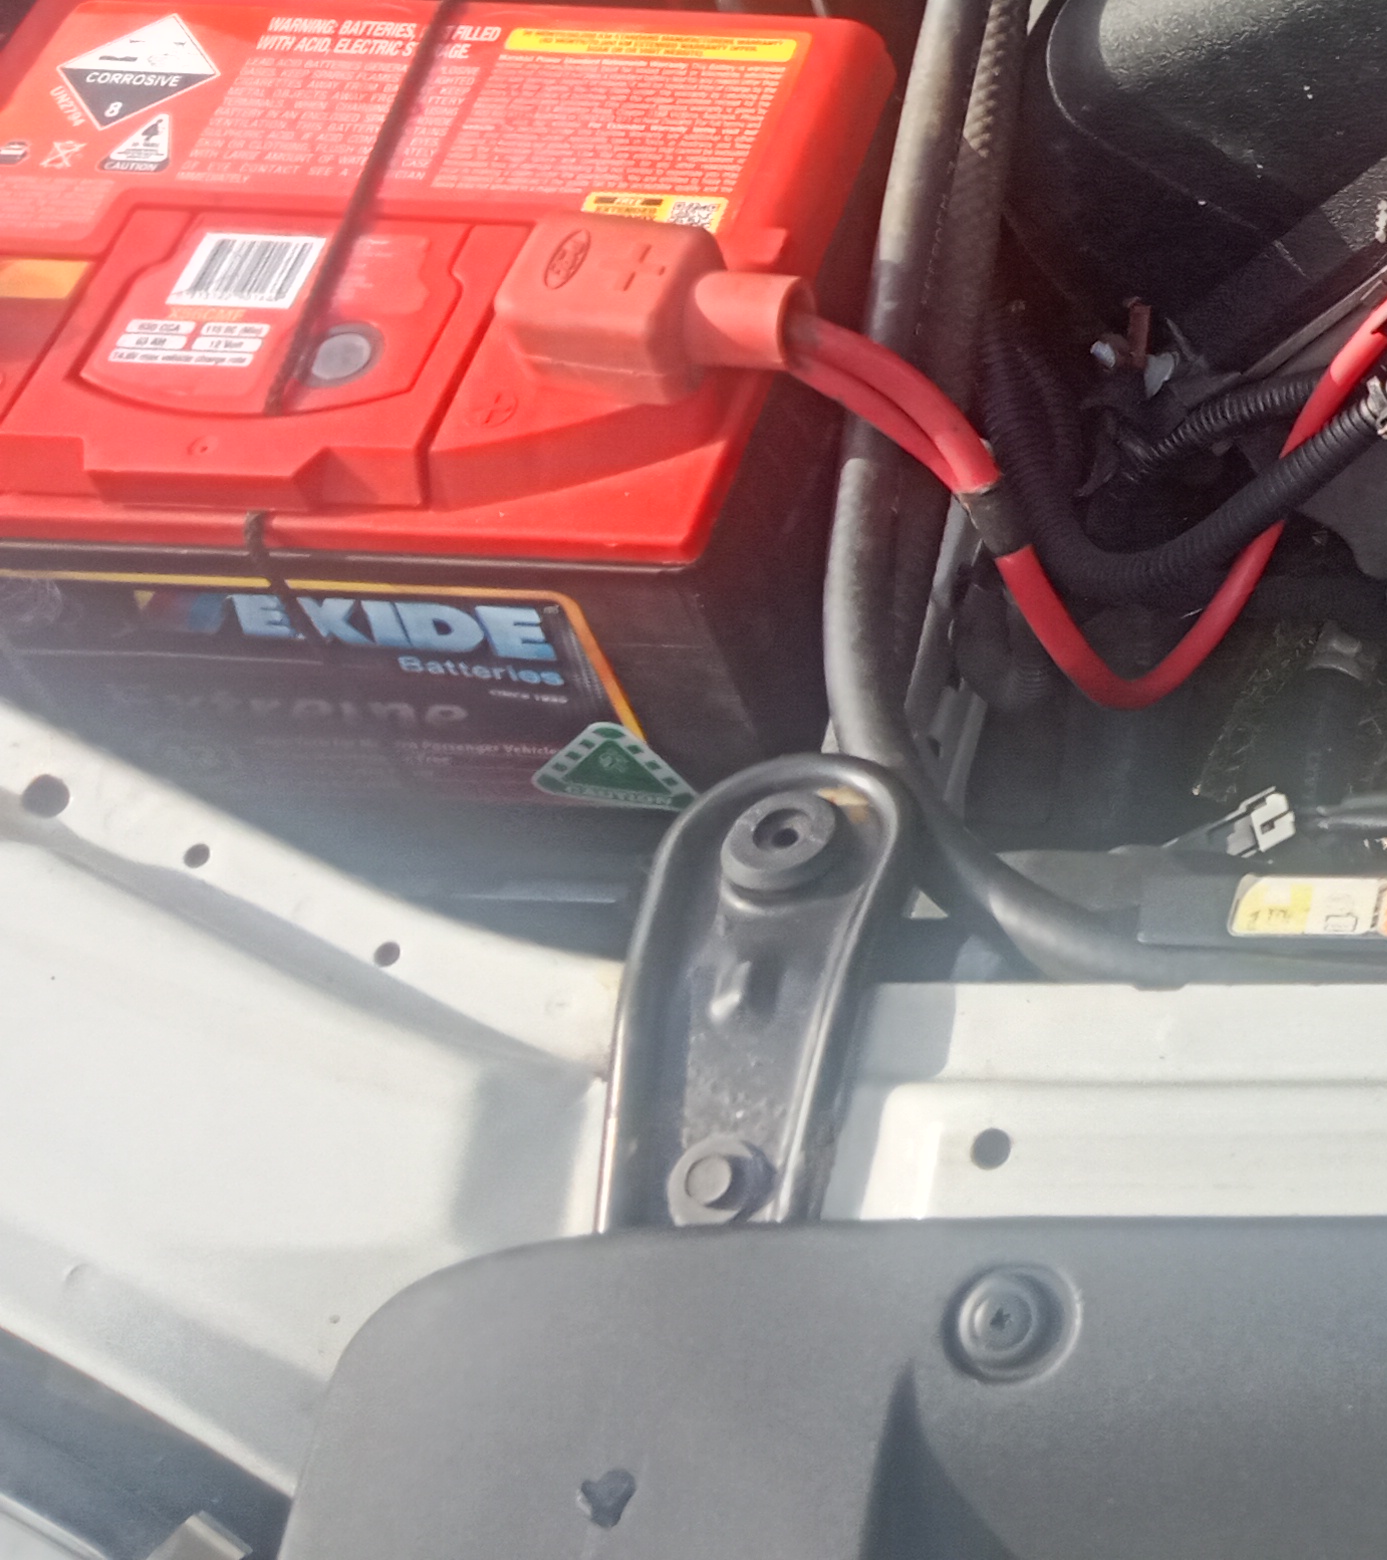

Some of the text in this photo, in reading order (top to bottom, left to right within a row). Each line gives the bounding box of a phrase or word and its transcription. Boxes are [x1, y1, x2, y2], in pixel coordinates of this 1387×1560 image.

[267, 17, 339, 35] WARNING:
[337, 20, 418, 40] BATTERIES,
[452, 24, 502, 42] FILLED
[256, 35, 294, 51] WITH
[292, 37, 331, 55] ACID,
[333, 38, 402, 56] ELECTRIC
[85, 72, 183, 88] CORROSIVE
[49, 85, 87, 128] UN2794
[104, 101, 123, 118] 8
[104, 162, 161, 172] CAUTION
[239, 162, 302, 175] CONTACT
[227, 593, 557, 662] EXIDE
[397, 655, 565, 686] Batteries
[421, 741, 499, 755] Passenger
